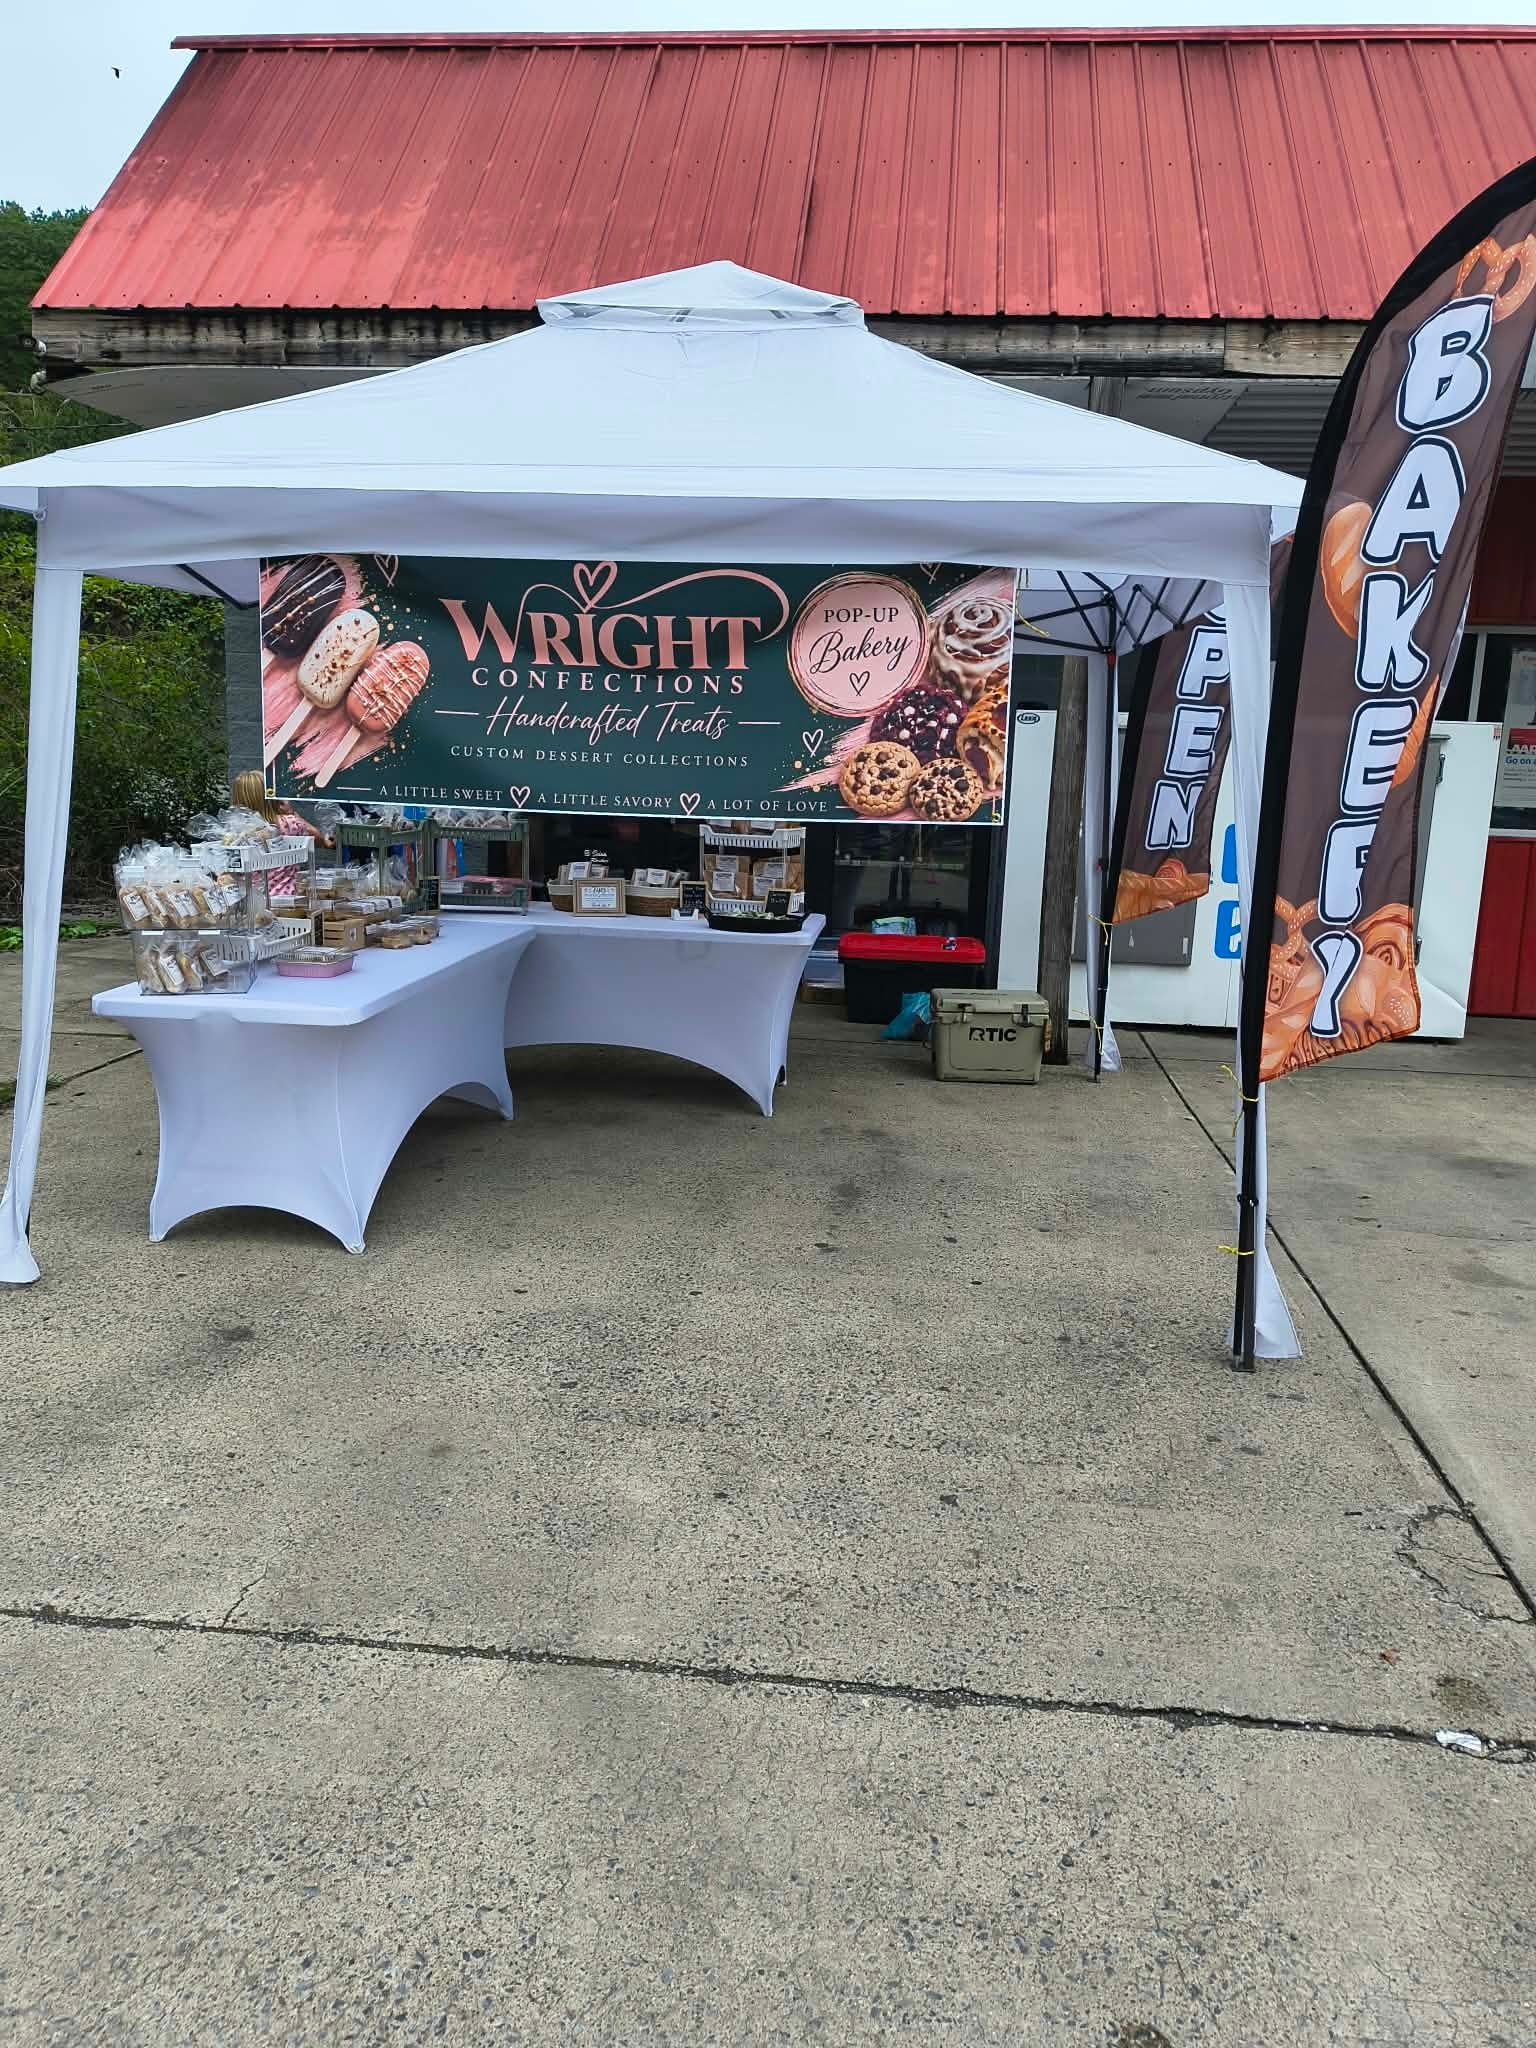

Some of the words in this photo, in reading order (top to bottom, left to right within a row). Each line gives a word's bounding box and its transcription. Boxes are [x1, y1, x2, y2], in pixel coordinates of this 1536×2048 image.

[438, 598, 762, 670] WRIGHT
[823, 606, 900, 625] POP-UP
[809, 627, 913, 674] Bakery
[1310, 293, 1496, 1038] BAKERY
[471, 667, 745, 695] CONFECTIONS
[486, 695, 647, 746] Handcrafted
[654, 700, 734, 742] Treats
[1144, 604, 1232, 850] PEN
[450, 745, 525, 760] CUSTOM
[535, 749, 613, 763] DESSERT
[623, 752, 749, 768] COLLECTIONS
[379, 785, 388, 797] A
[395, 785, 448, 799] LITTLE
[454, 787, 502, 802] SWEET
[537, 793, 547, 804] A
[553, 793, 609, 807] LITTLE
[614, 794, 673, 809] SAVORY
[707, 799, 716, 811] A
[720, 799, 754, 812] LOT
[760, 799, 780, 812] OF
[786, 800, 828, 813] LOVE
[968, 1027, 1017, 1042] RTIC
